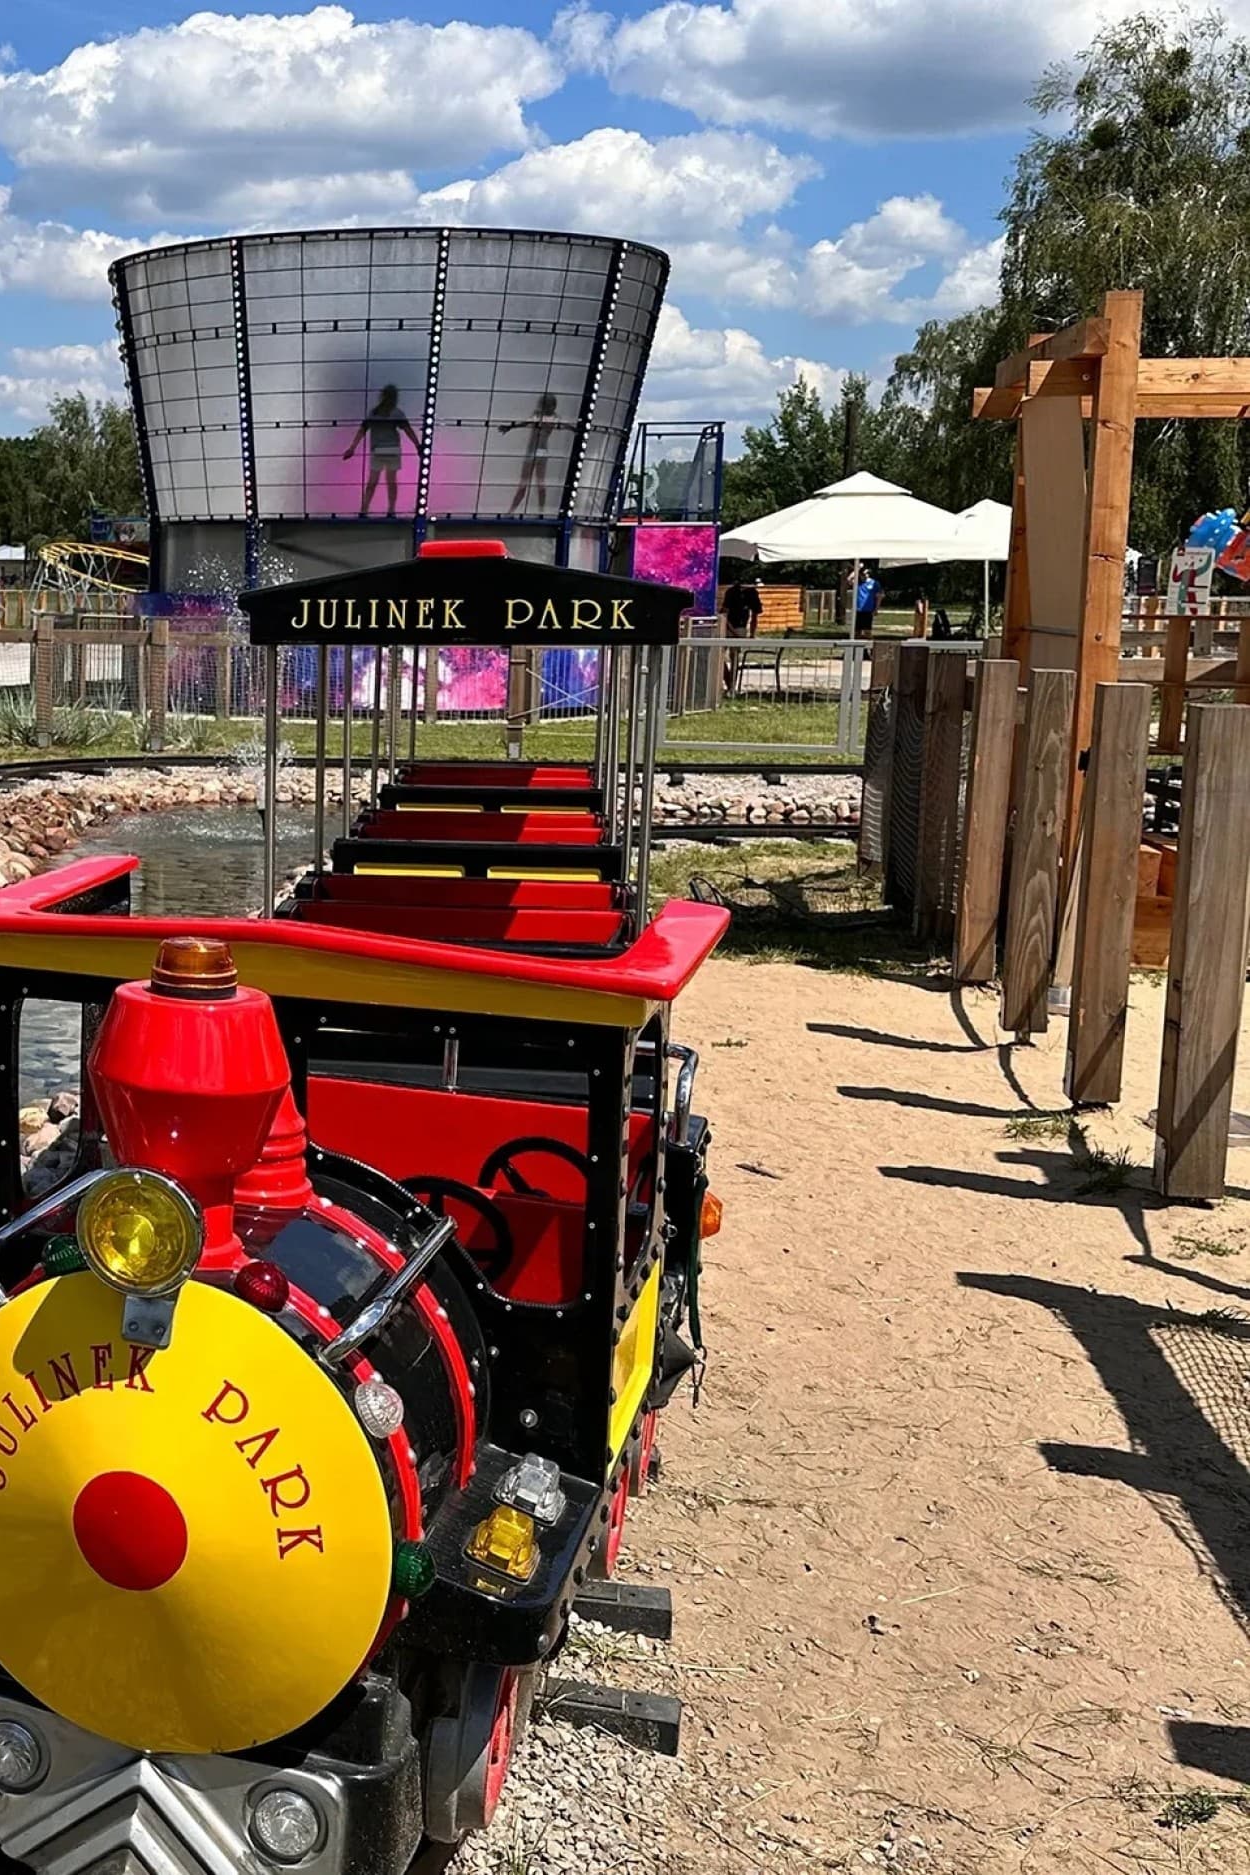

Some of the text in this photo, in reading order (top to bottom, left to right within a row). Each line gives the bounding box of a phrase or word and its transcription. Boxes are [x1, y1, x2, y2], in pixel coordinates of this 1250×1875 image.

[291, 598, 636, 630] JULINEK PARK
[201, 1379, 324, 1560] PARK
